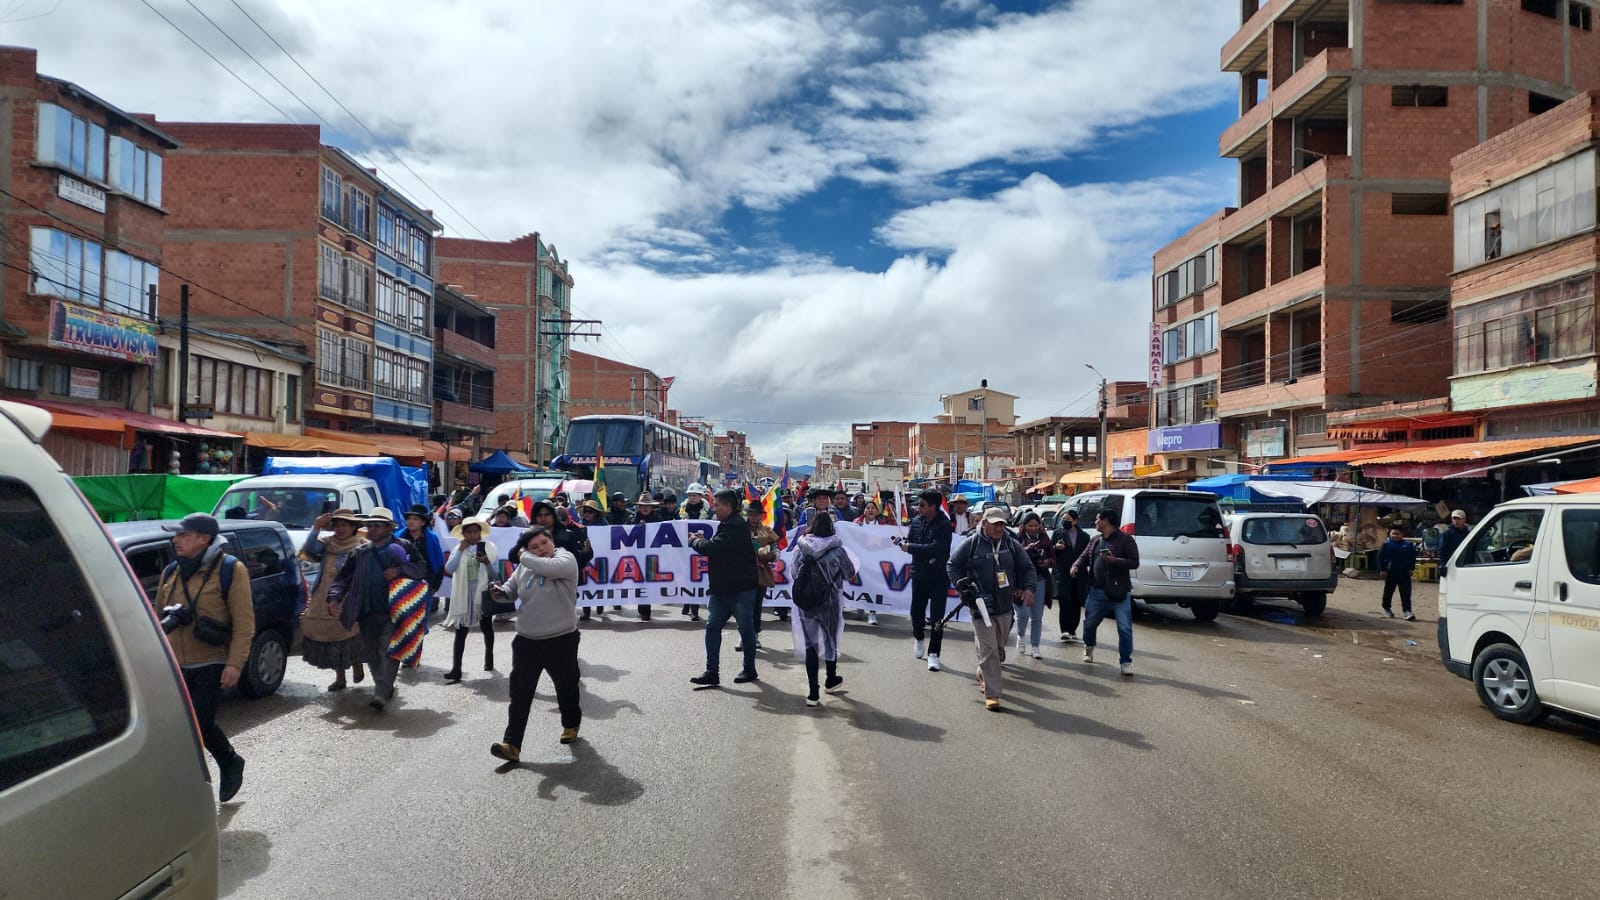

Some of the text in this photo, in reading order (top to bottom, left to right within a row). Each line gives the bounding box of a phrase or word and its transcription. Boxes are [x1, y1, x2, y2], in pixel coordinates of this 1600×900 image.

[64, 316, 158, 358] TRUENOVISION
[1151, 329, 1161, 386] FARMACIA
[570, 456, 633, 465] LLALAGUA
[1562, 616, 1599, 630] TOYOTA
